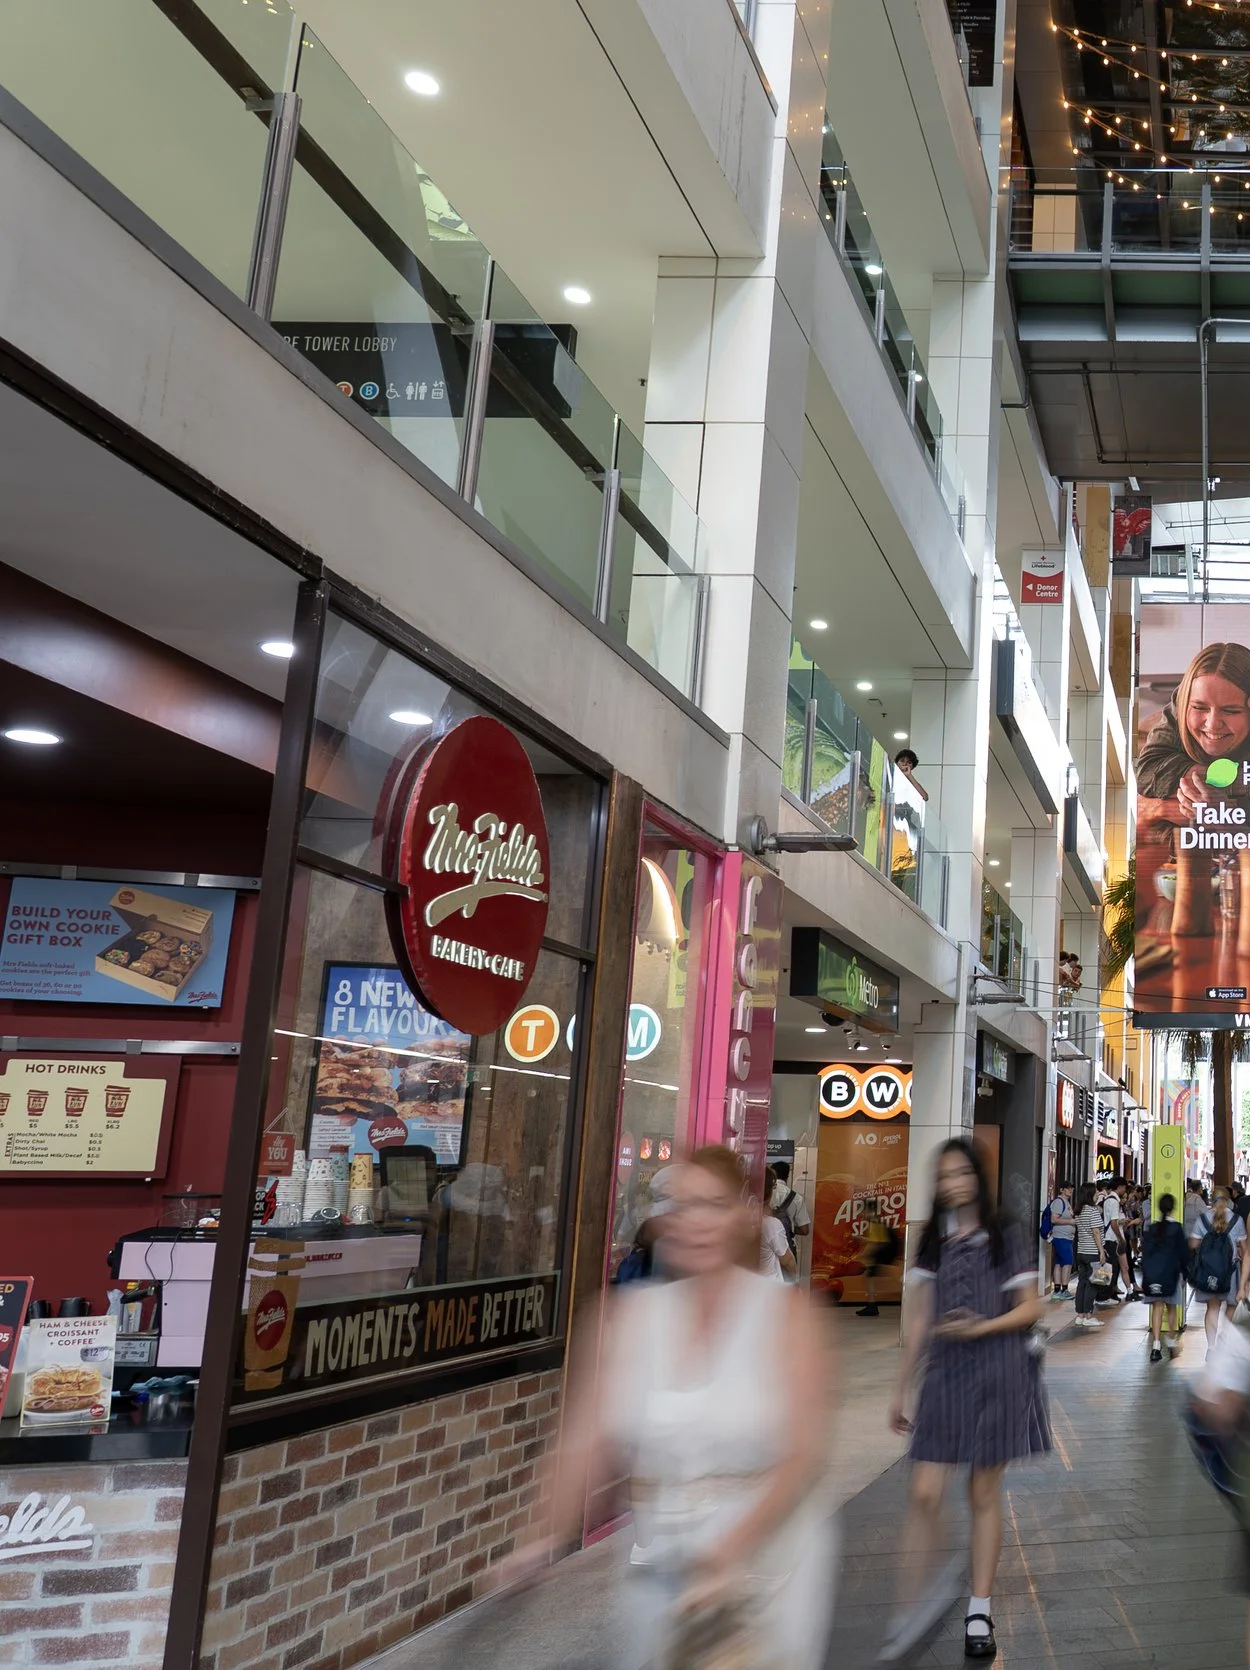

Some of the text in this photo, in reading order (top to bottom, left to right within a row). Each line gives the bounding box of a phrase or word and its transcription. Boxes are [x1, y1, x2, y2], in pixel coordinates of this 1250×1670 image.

[304, 336, 350, 352] TOWER
[354, 336, 397, 352] LOBBY
[1191, 801, 1246, 825] Take
[11, 905, 112, 921] BUILD YOUR
[9, 919, 120, 936] OWN COOKIE
[7, 933, 83, 947] GIFT BOX
[334, 979, 414, 1008] 8 NEW
[859, 974, 879, 1009] Metro
[25, 1063, 107, 1075] HOT DRINKS
[5, 1133, 14, 1158] EXTRAS
[268, 1147, 288, 1160] YOU
[853, 1188, 884, 1199] COCKTAIL
[74, 1319, 108, 1327] CHEESE
[304, 1284, 545, 1378] MOMENTS MADE BETTER
[47, 1328, 100, 1338] CROISSANT
